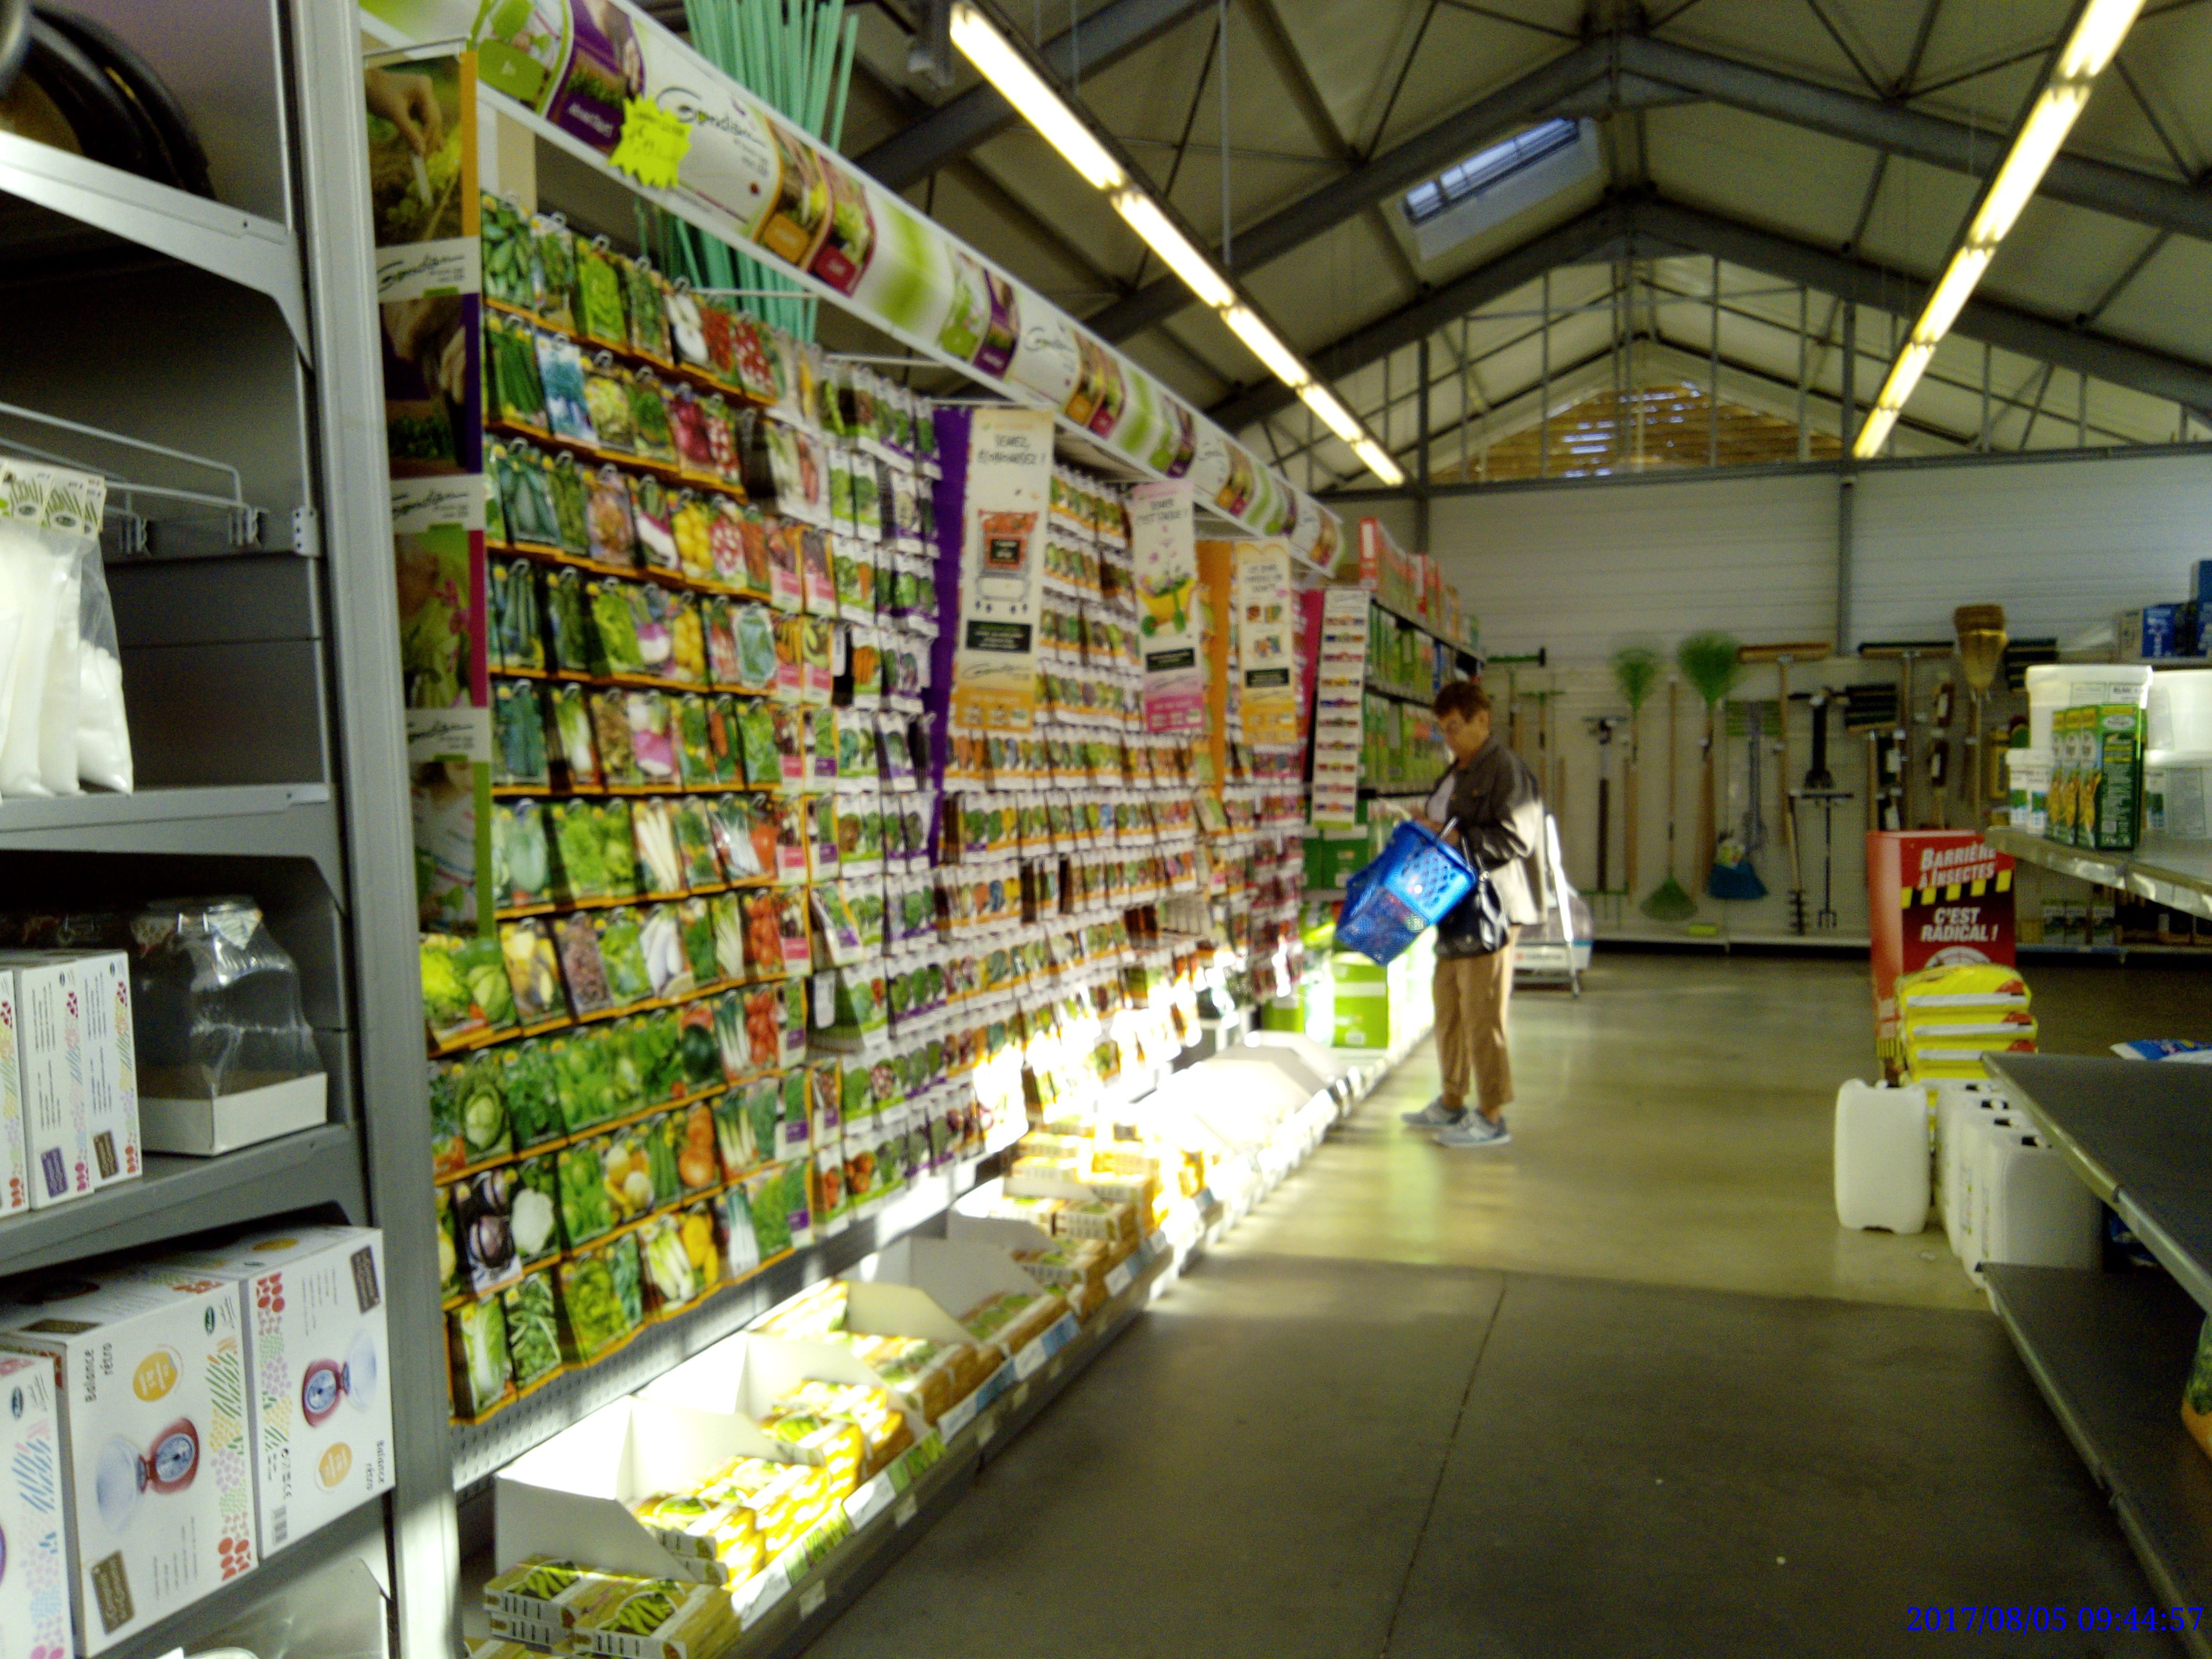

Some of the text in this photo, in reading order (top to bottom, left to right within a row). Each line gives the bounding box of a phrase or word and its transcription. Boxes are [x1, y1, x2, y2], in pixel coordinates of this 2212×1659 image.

[1934, 907, 1981, 925] C'EST
[1920, 923, 1989, 942] RADICAL
[85, 1348, 97, 1403] Balance
